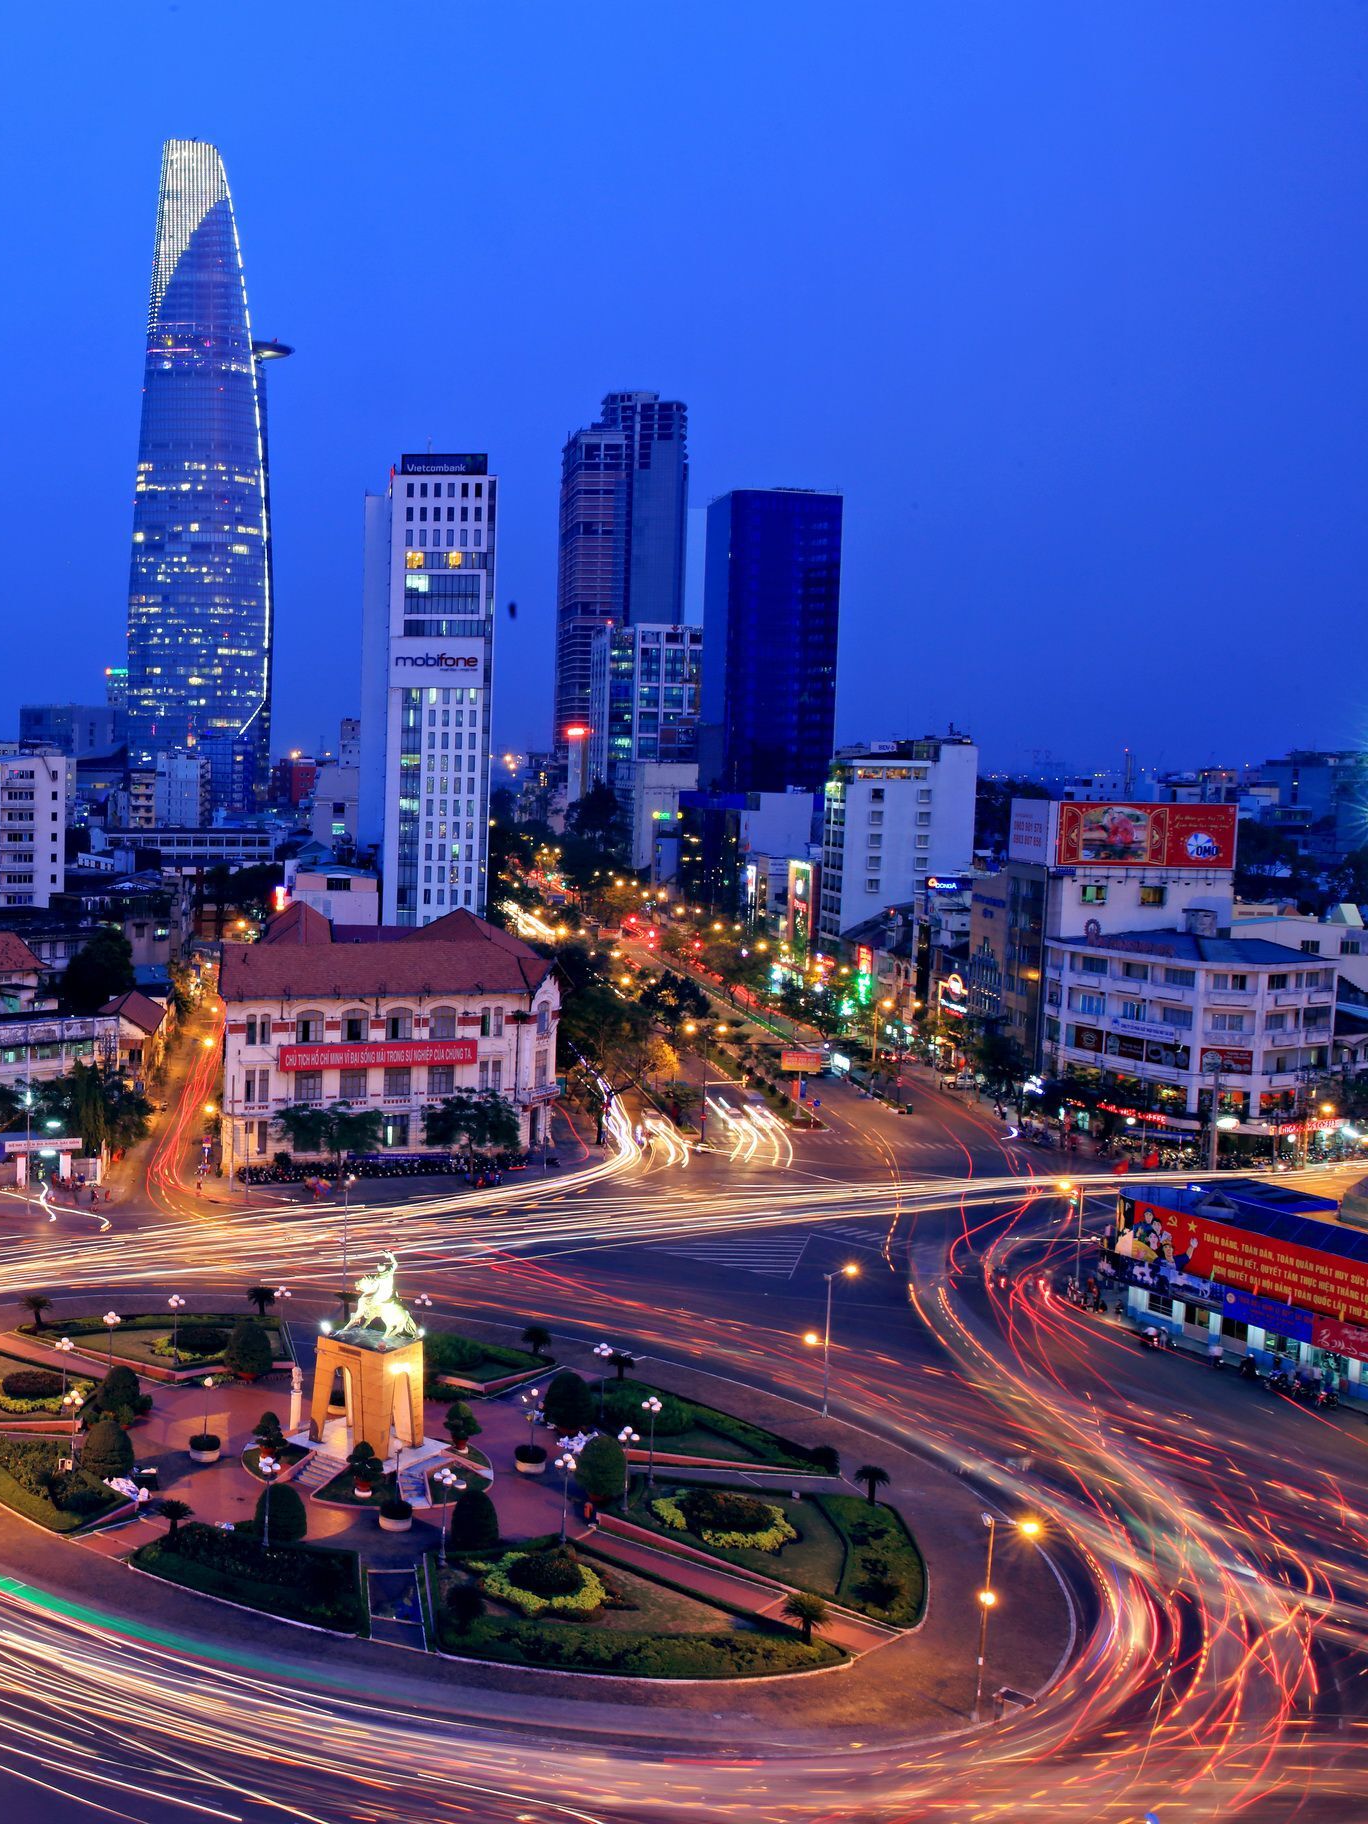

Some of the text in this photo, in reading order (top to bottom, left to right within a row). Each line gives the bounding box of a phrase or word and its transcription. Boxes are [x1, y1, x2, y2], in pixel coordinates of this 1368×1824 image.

[407, 464, 466, 472] Vietcombank
[395, 653, 478, 667] mobifone
[1196, 846, 1219, 856] OMO
[286, 1050, 296, 1066] CHỦ
[298, 1053, 310, 1068] TỊCH
[311, 1049, 319, 1065] HỒ
[320, 1050, 330, 1065] CHÍ
[330, 1052, 343, 1064] MINH
[360, 1046, 375, 1063] SỐNG
[387, 1050, 404, 1062] TRONG
[414, 1046, 432, 1063] NGHIỆP
[433, 1045, 444, 1060] CỦA
[445, 1045, 463, 1060] CHÚNG
[1204, 1233, 1219, 1244] TOÀN
[1242, 1243, 1258, 1255] TOÀN
[1276, 1254, 1294, 1266] TOÀN
[1296, 1259, 1314, 1272] QUÂN
[1315, 1265, 1332, 1277] PHÁT
[1335, 1270, 1349, 1281] HUY
[1351, 1273, 1365, 1286] SỨC
[1214, 1250, 1225, 1262] ĐẠI
[1226, 1254, 1243, 1266] ĐOÀN
[1260, 1264, 1282, 1277] QUYẾT
[1284, 1270, 1298, 1282] TÂM
[1300, 1275, 1317, 1288] THỰC
[1318, 1281, 1335, 1293] HIỆN
[1336, 1285, 1360, 1300] THẮNG
[1227, 1269, 1248, 1282] QUYẾT
[1250, 1276, 1260, 1286] ĐẠI
[1262, 1279, 1273, 1290] HỘI
[1275, 1282, 1292, 1295] ĐẢNG
[1294, 1289, 1312, 1301] TOÀN
[1313, 1295, 1332, 1307] QUỐC
[1333, 1299, 1347, 1312] LẦN
[1349, 1304, 1363, 1316] THỨ
